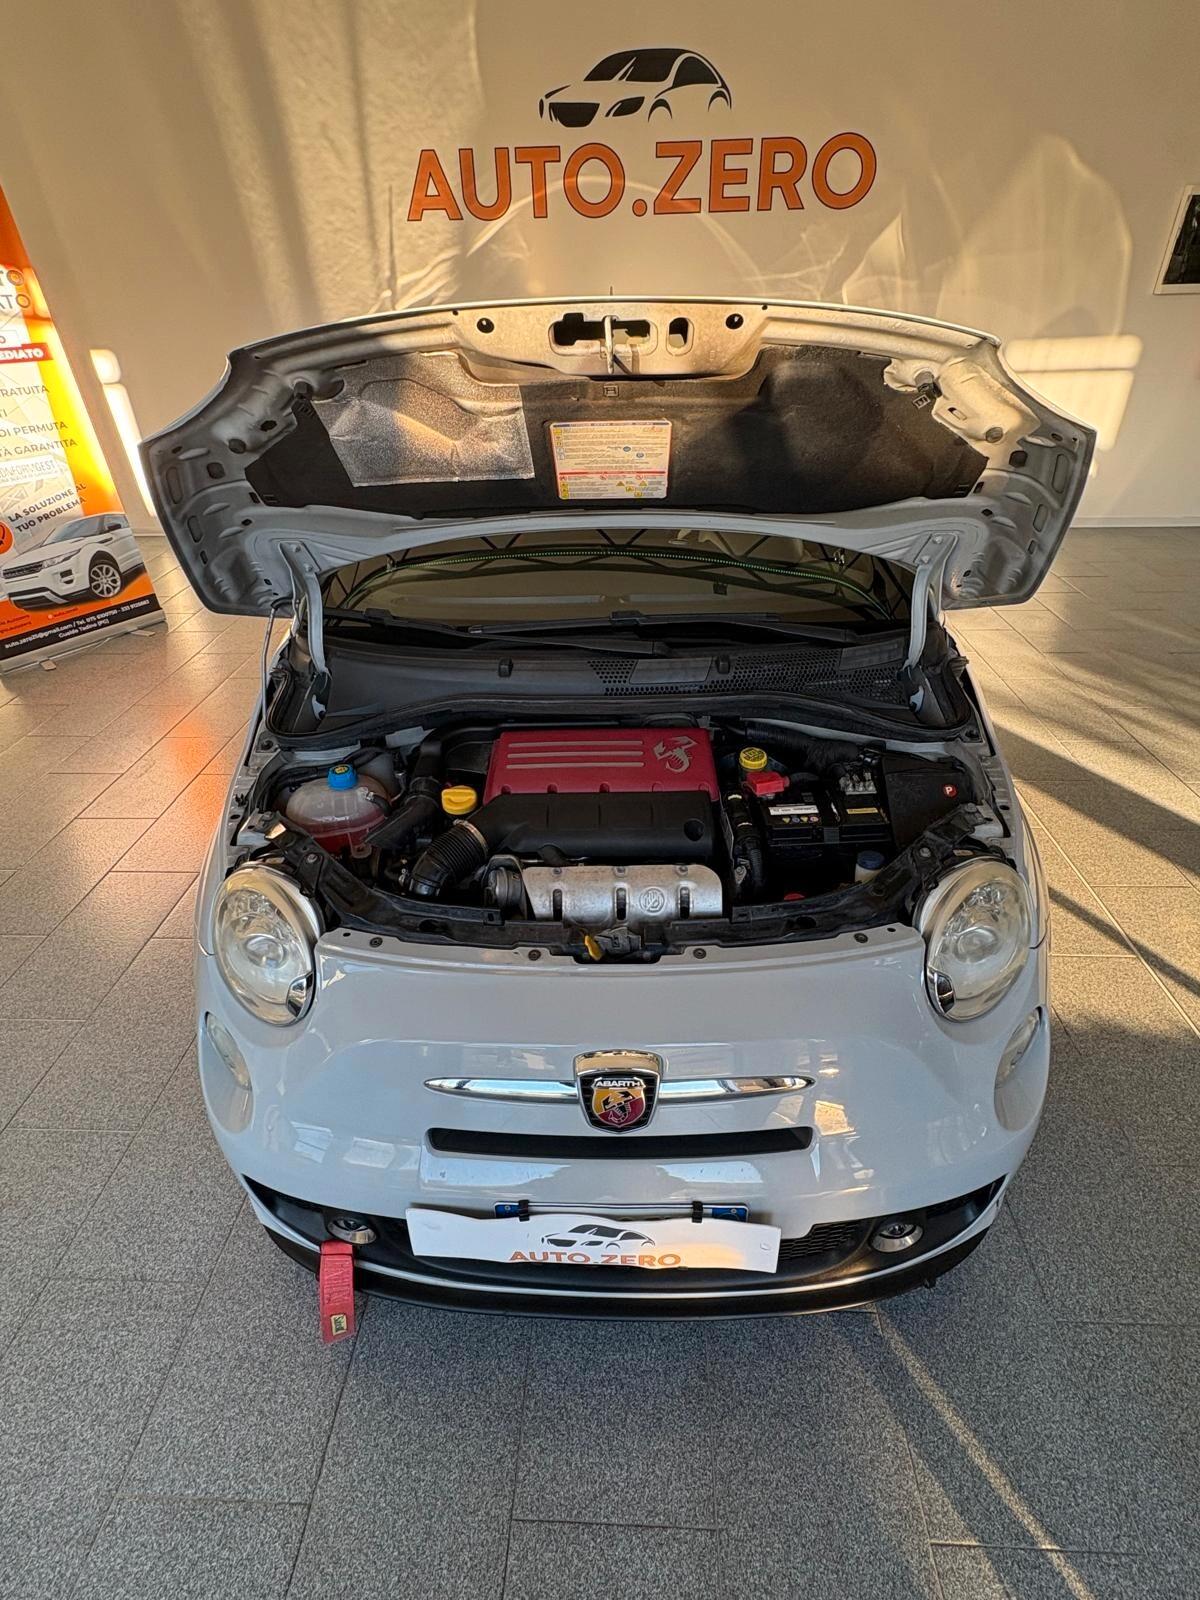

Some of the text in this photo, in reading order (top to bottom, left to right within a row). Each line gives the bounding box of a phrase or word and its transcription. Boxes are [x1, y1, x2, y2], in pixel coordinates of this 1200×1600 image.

[407, 132, 877, 221] AUTO.ZERO
[13, 421, 68, 436] PERMUTA
[14, 439, 78, 455] GARANTITA
[8, 483, 87, 522] LA SOLUZIONE AL
[15, 496, 86, 533] TUO PROBLEMA
